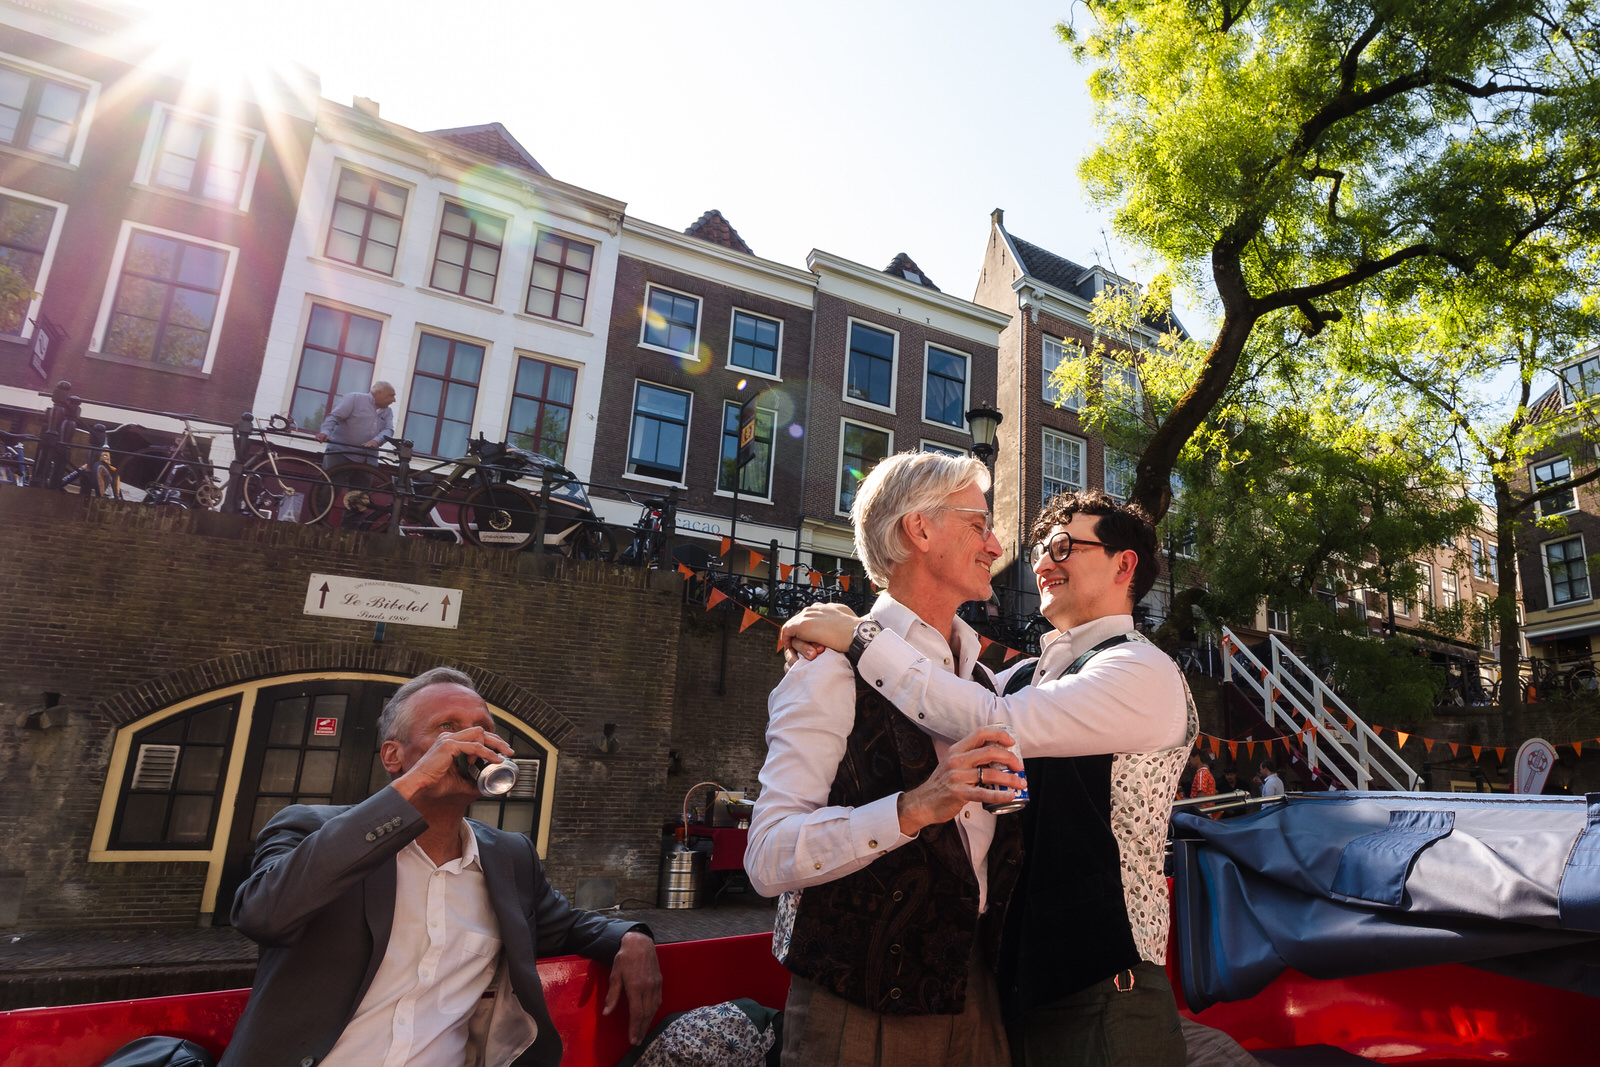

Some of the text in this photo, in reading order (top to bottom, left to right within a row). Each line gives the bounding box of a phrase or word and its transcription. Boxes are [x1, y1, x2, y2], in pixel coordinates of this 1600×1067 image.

[343, 592, 429, 613] Le Bibelot
[357, 610, 409, 622] Sinds 1980
